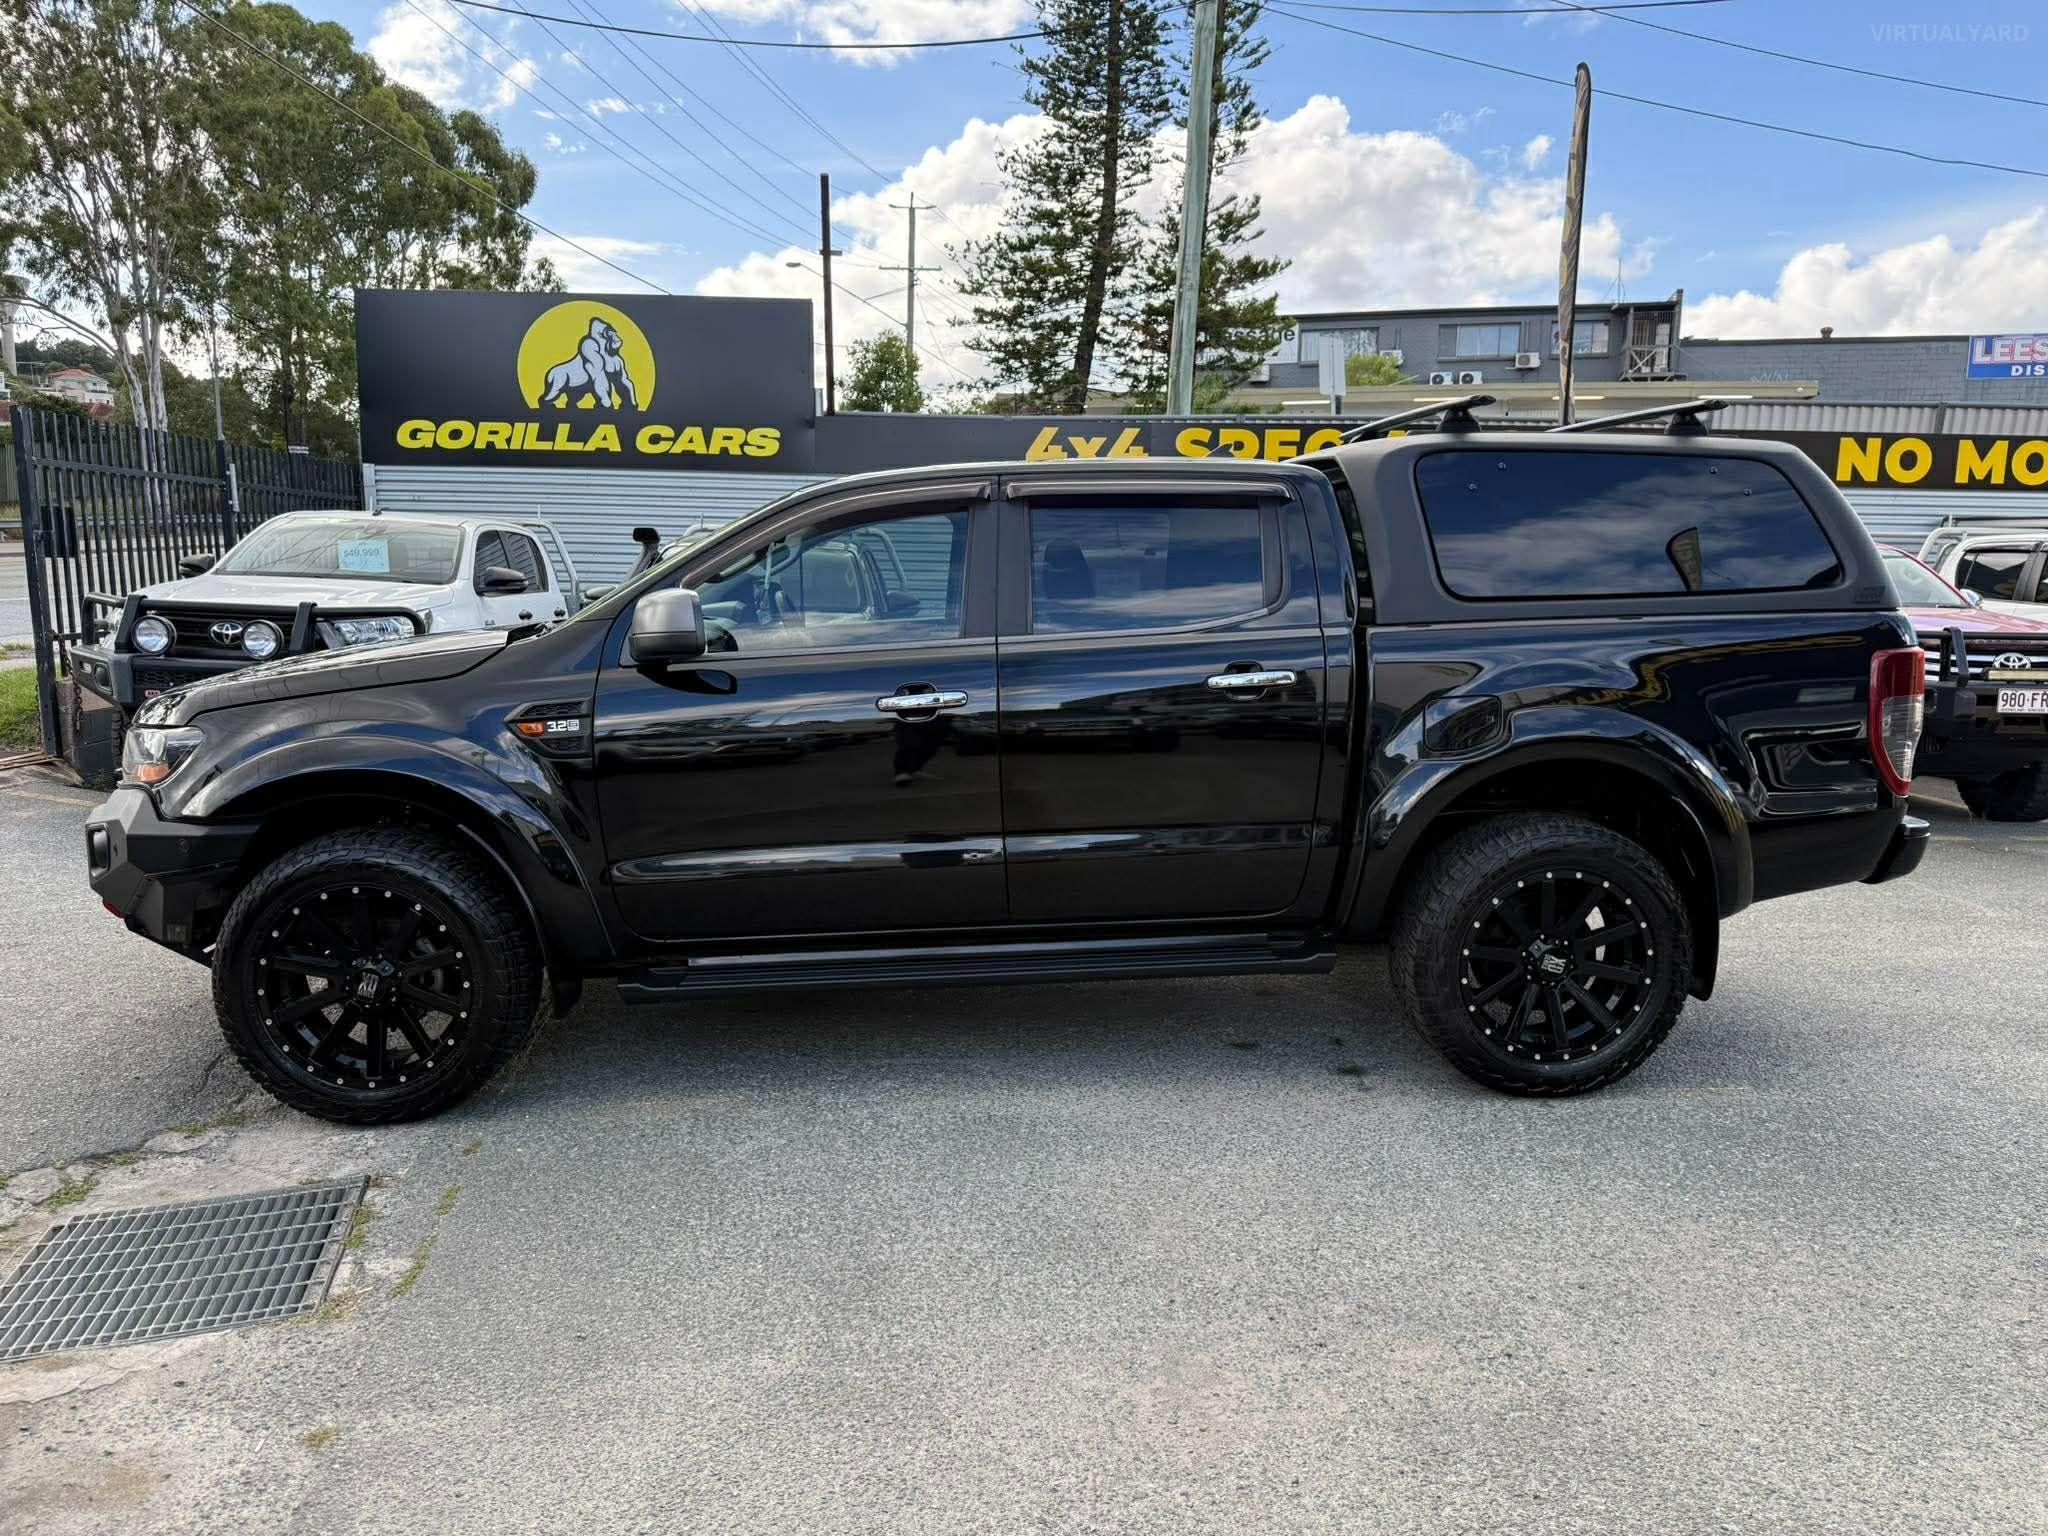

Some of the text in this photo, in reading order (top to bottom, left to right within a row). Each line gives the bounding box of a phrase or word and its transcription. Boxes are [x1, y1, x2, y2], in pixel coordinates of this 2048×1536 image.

[396, 419, 782, 457] GORILLA CARS
[1836, 437, 2048, 486] NO MO
